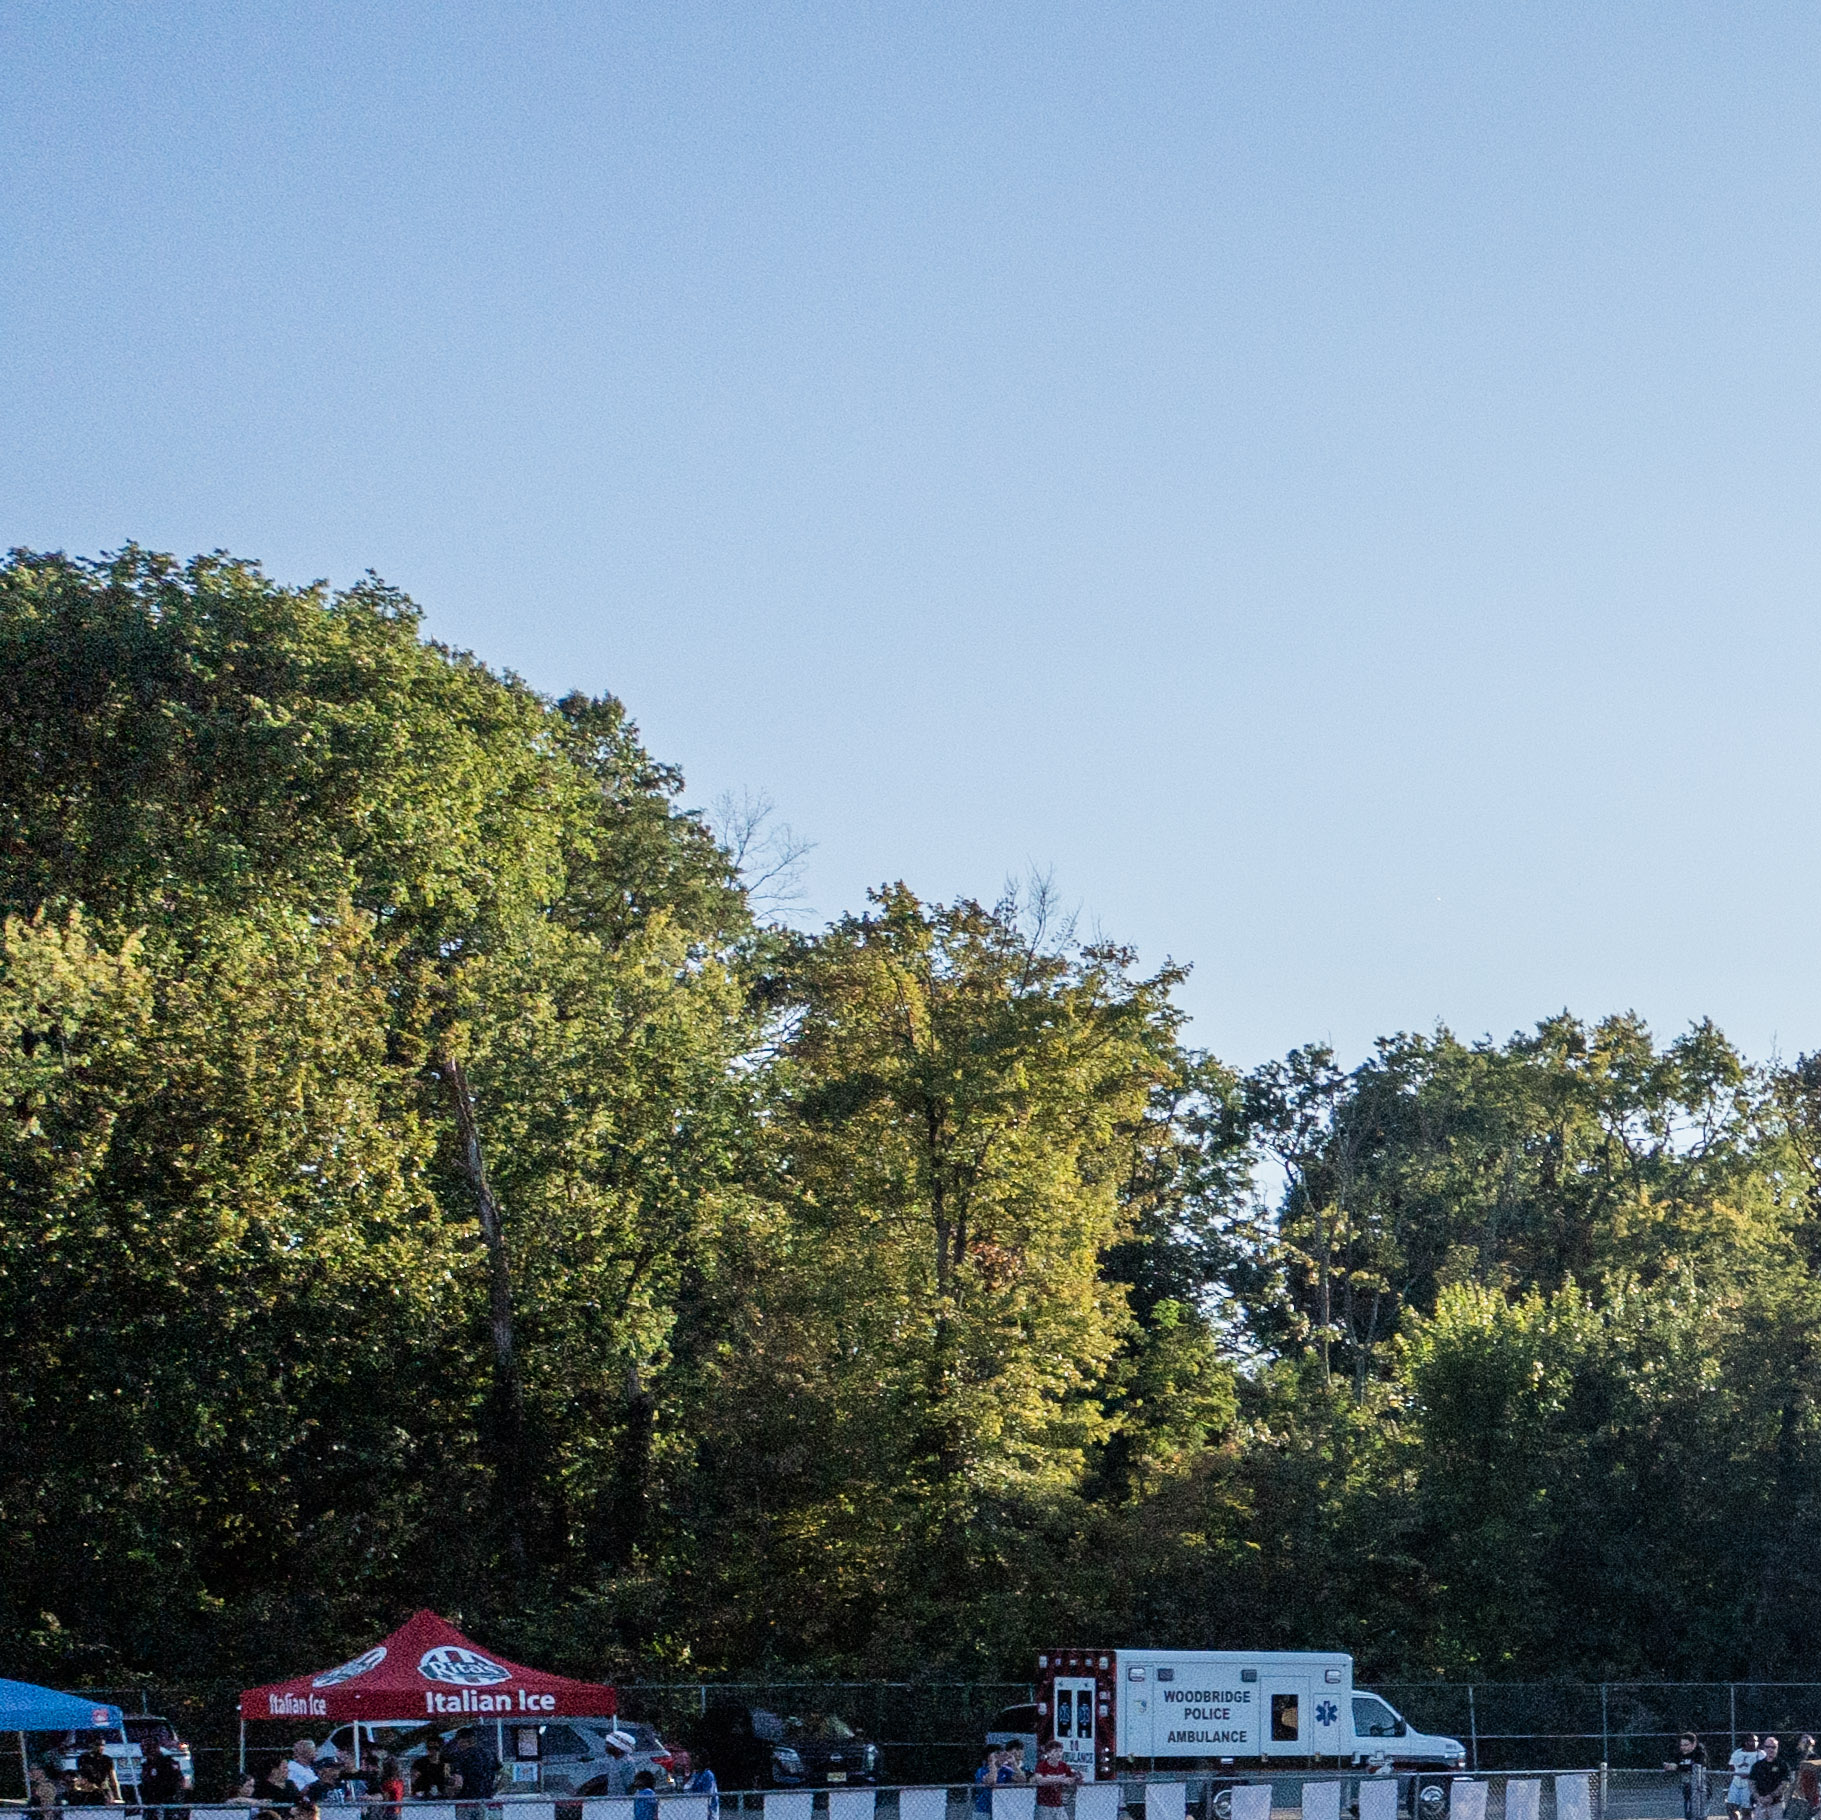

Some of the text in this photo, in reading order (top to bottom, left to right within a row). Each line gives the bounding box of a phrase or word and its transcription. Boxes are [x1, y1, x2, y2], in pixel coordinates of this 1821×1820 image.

[429, 1659, 503, 1678] Rita's
[268, 1693, 326, 1716] Italian Ice
[426, 1689, 555, 1713] Italian Ice
[1164, 1690, 1251, 1704] WOODBRIDGE
[1184, 1707, 1230, 1720] POLICE
[1167, 1730, 1247, 1744] AMBULANCE
